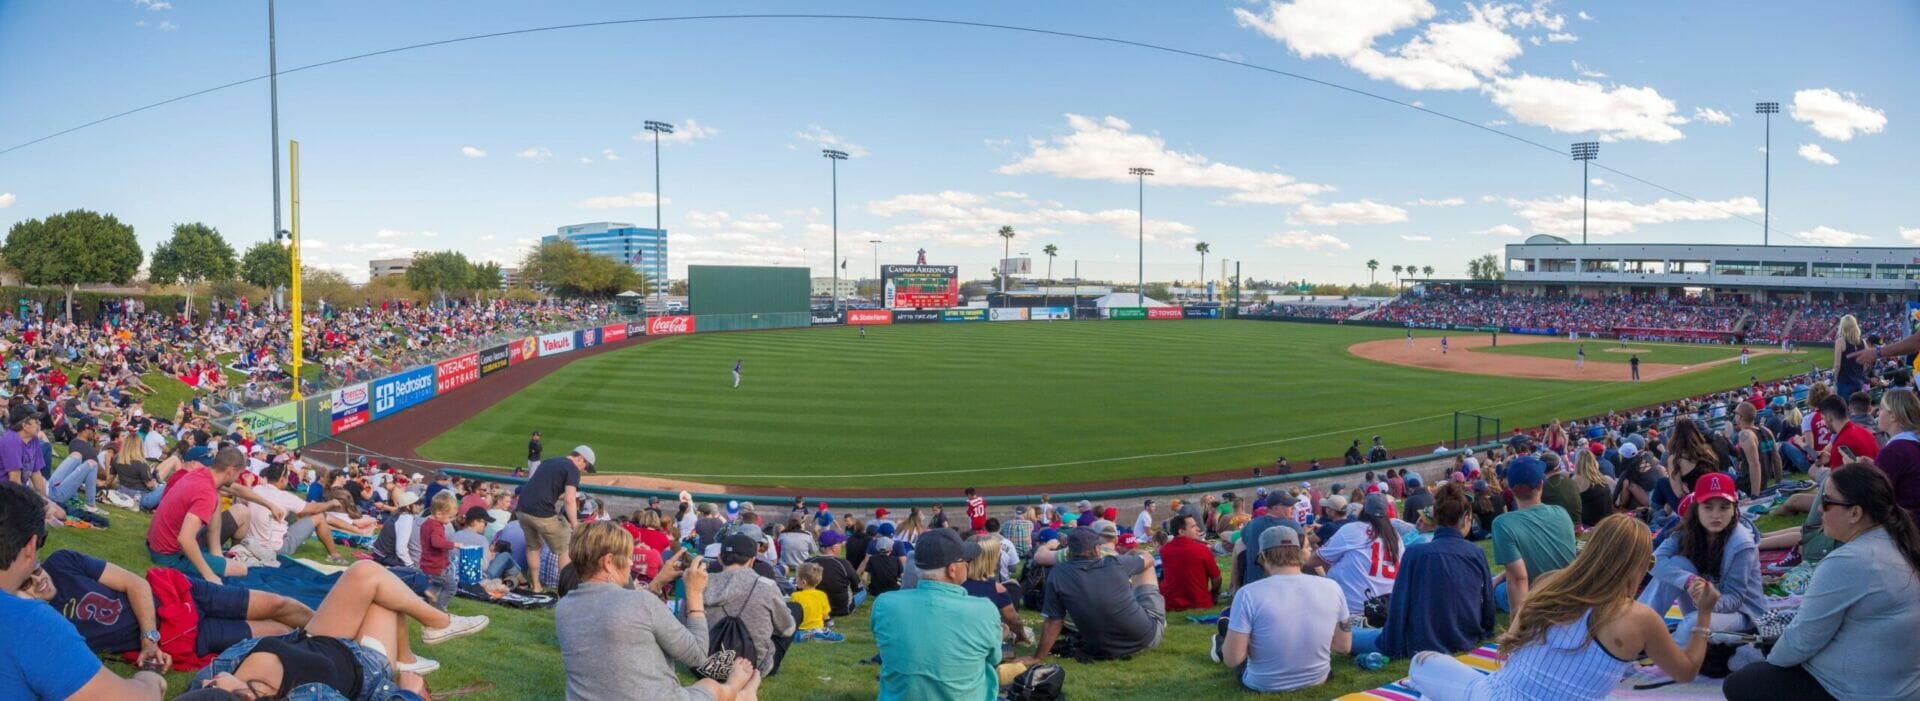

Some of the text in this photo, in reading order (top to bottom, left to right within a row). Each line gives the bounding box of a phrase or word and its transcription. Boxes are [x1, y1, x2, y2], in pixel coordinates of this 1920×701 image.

[543, 336, 570, 352] Yakult
[439, 354, 478, 377] INTERACTIVE
[395, 373, 432, 398] Bedrosians
[438, 369, 478, 392] MORTGAGE
[318, 399, 331, 412] 340
[1710, 476, 1721, 490] A
[973, 506, 985, 518] 10
